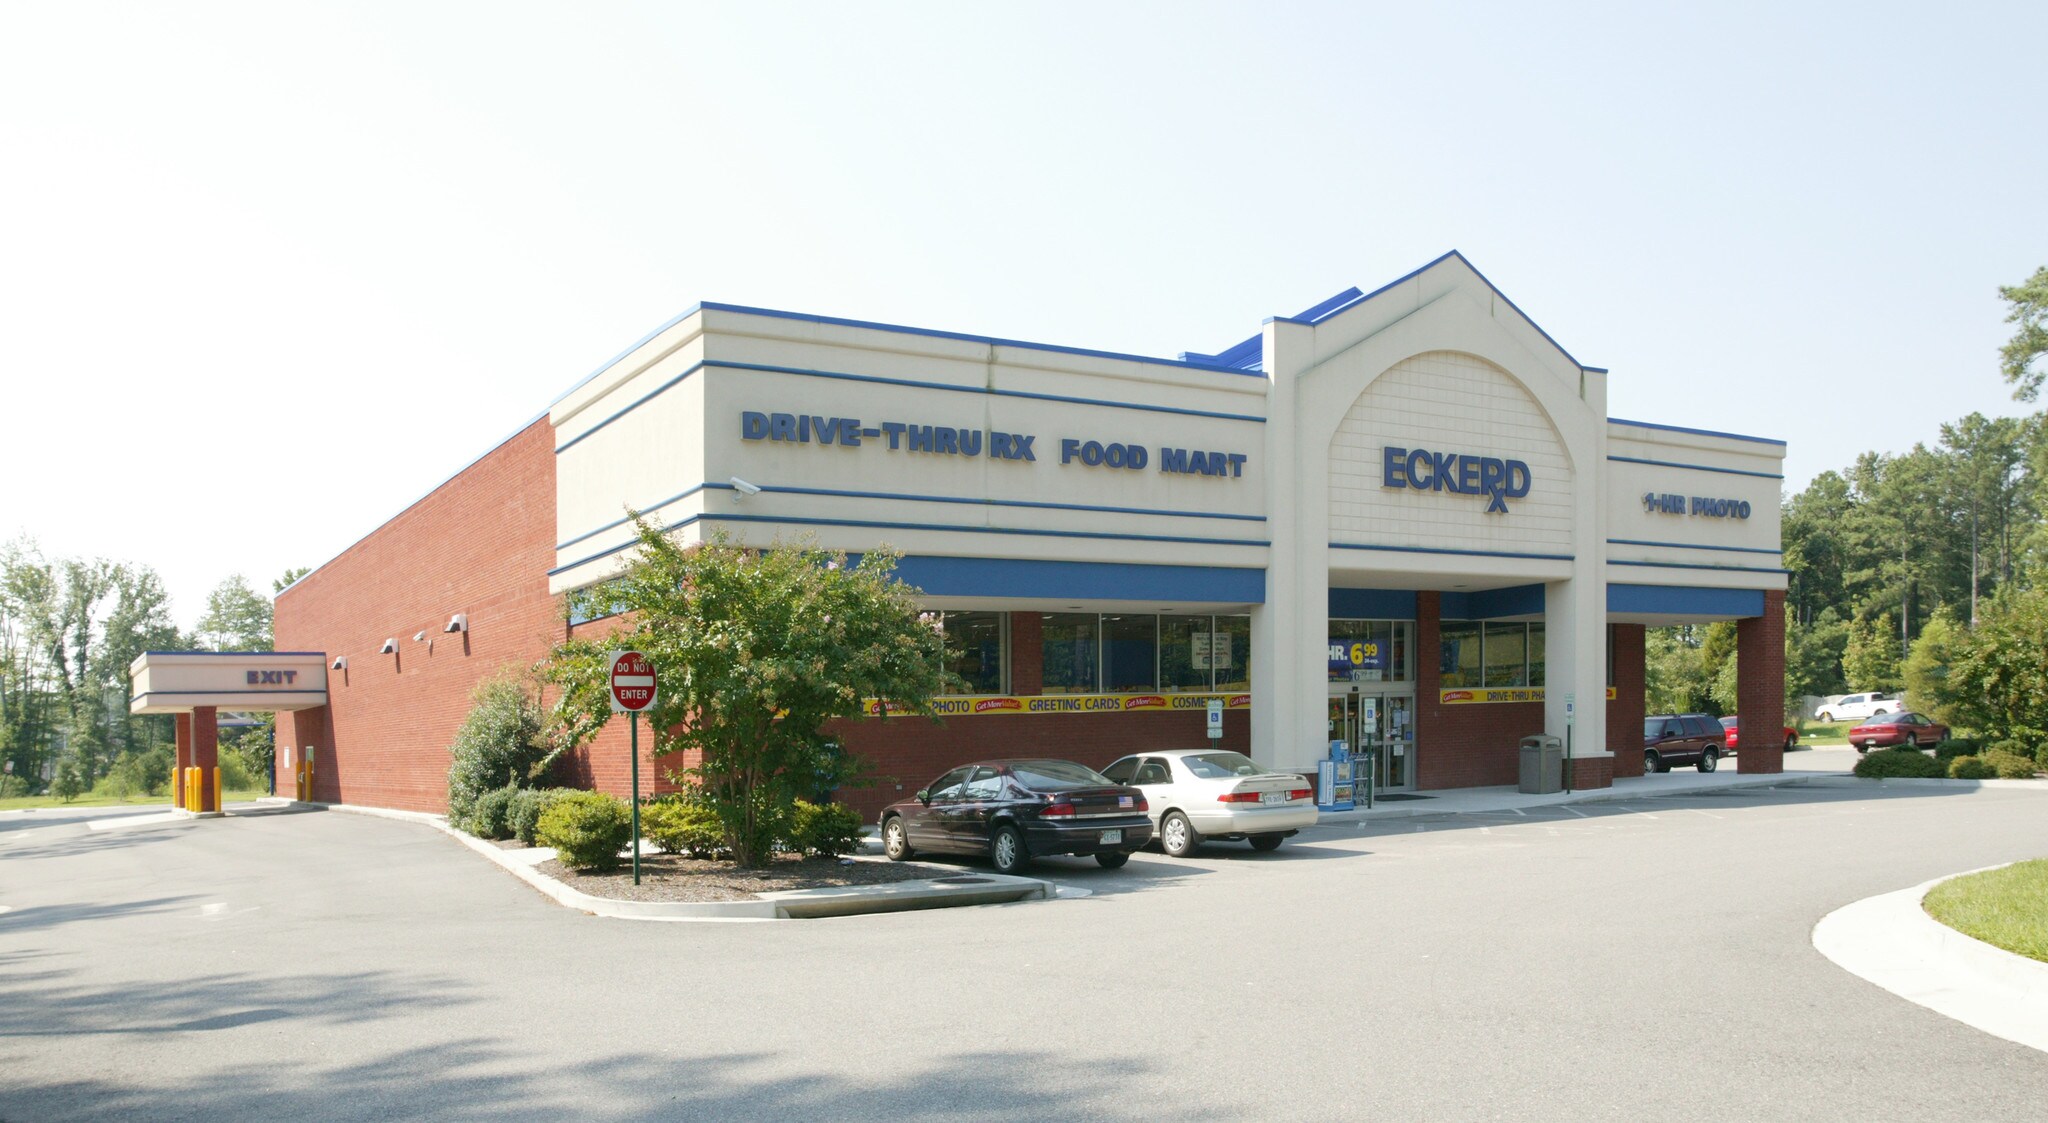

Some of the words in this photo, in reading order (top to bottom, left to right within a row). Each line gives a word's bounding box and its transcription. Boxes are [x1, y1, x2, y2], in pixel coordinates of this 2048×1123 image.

[742, 411, 982, 456] DRIVE-THRU
[990, 431, 1036, 461] RX
[1060, 438, 1148, 469] FOOD
[1161, 447, 1247, 478] MART
[1384, 446, 1532, 512] ECKERD
[1644, 492, 1686, 514] 1-HR
[1691, 496, 1751, 519] PHOTO
[617, 662, 629, 672] DO
[246, 670, 298, 684] EXIT
[620, 690, 648, 699] ENTER
[1487, 691, 1530, 701] DRIVE-THRU
[932, 700, 970, 713] PHOTO
[976, 702, 987, 711] Get
[1028, 699, 1081, 711] GREETING
[1085, 697, 1120, 710] CARDS
